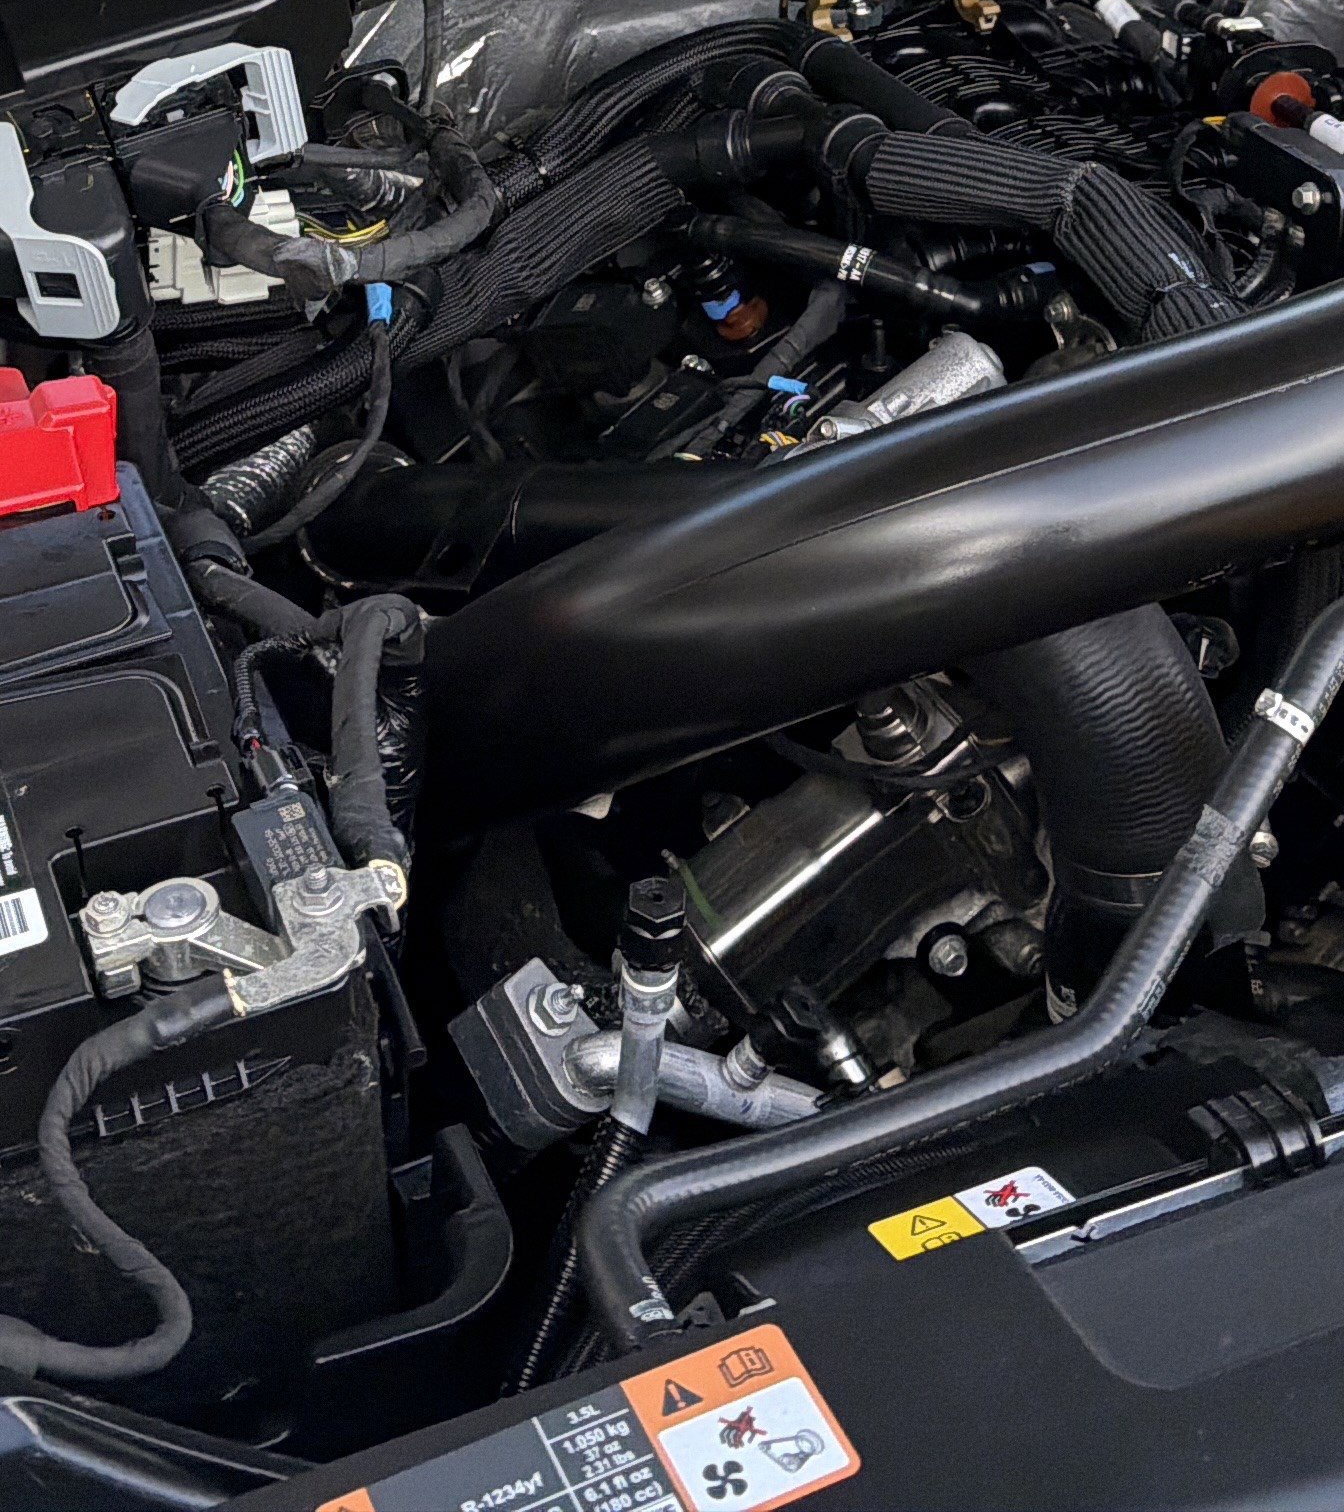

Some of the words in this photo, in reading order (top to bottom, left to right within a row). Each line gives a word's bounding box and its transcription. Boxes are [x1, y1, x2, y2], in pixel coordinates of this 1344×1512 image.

[566, 1404, 601, 1425] 3.5L
[563, 1430, 605, 1454] 1.050
[605, 1420, 631, 1437] kg
[582, 1445, 600, 1462] 37
[603, 1440, 622, 1454] oz
[629, 1466, 653, 1484] oz
[461, 1472, 544, 1512] R-1234yf
[634, 1480, 663, 1502] cc)
